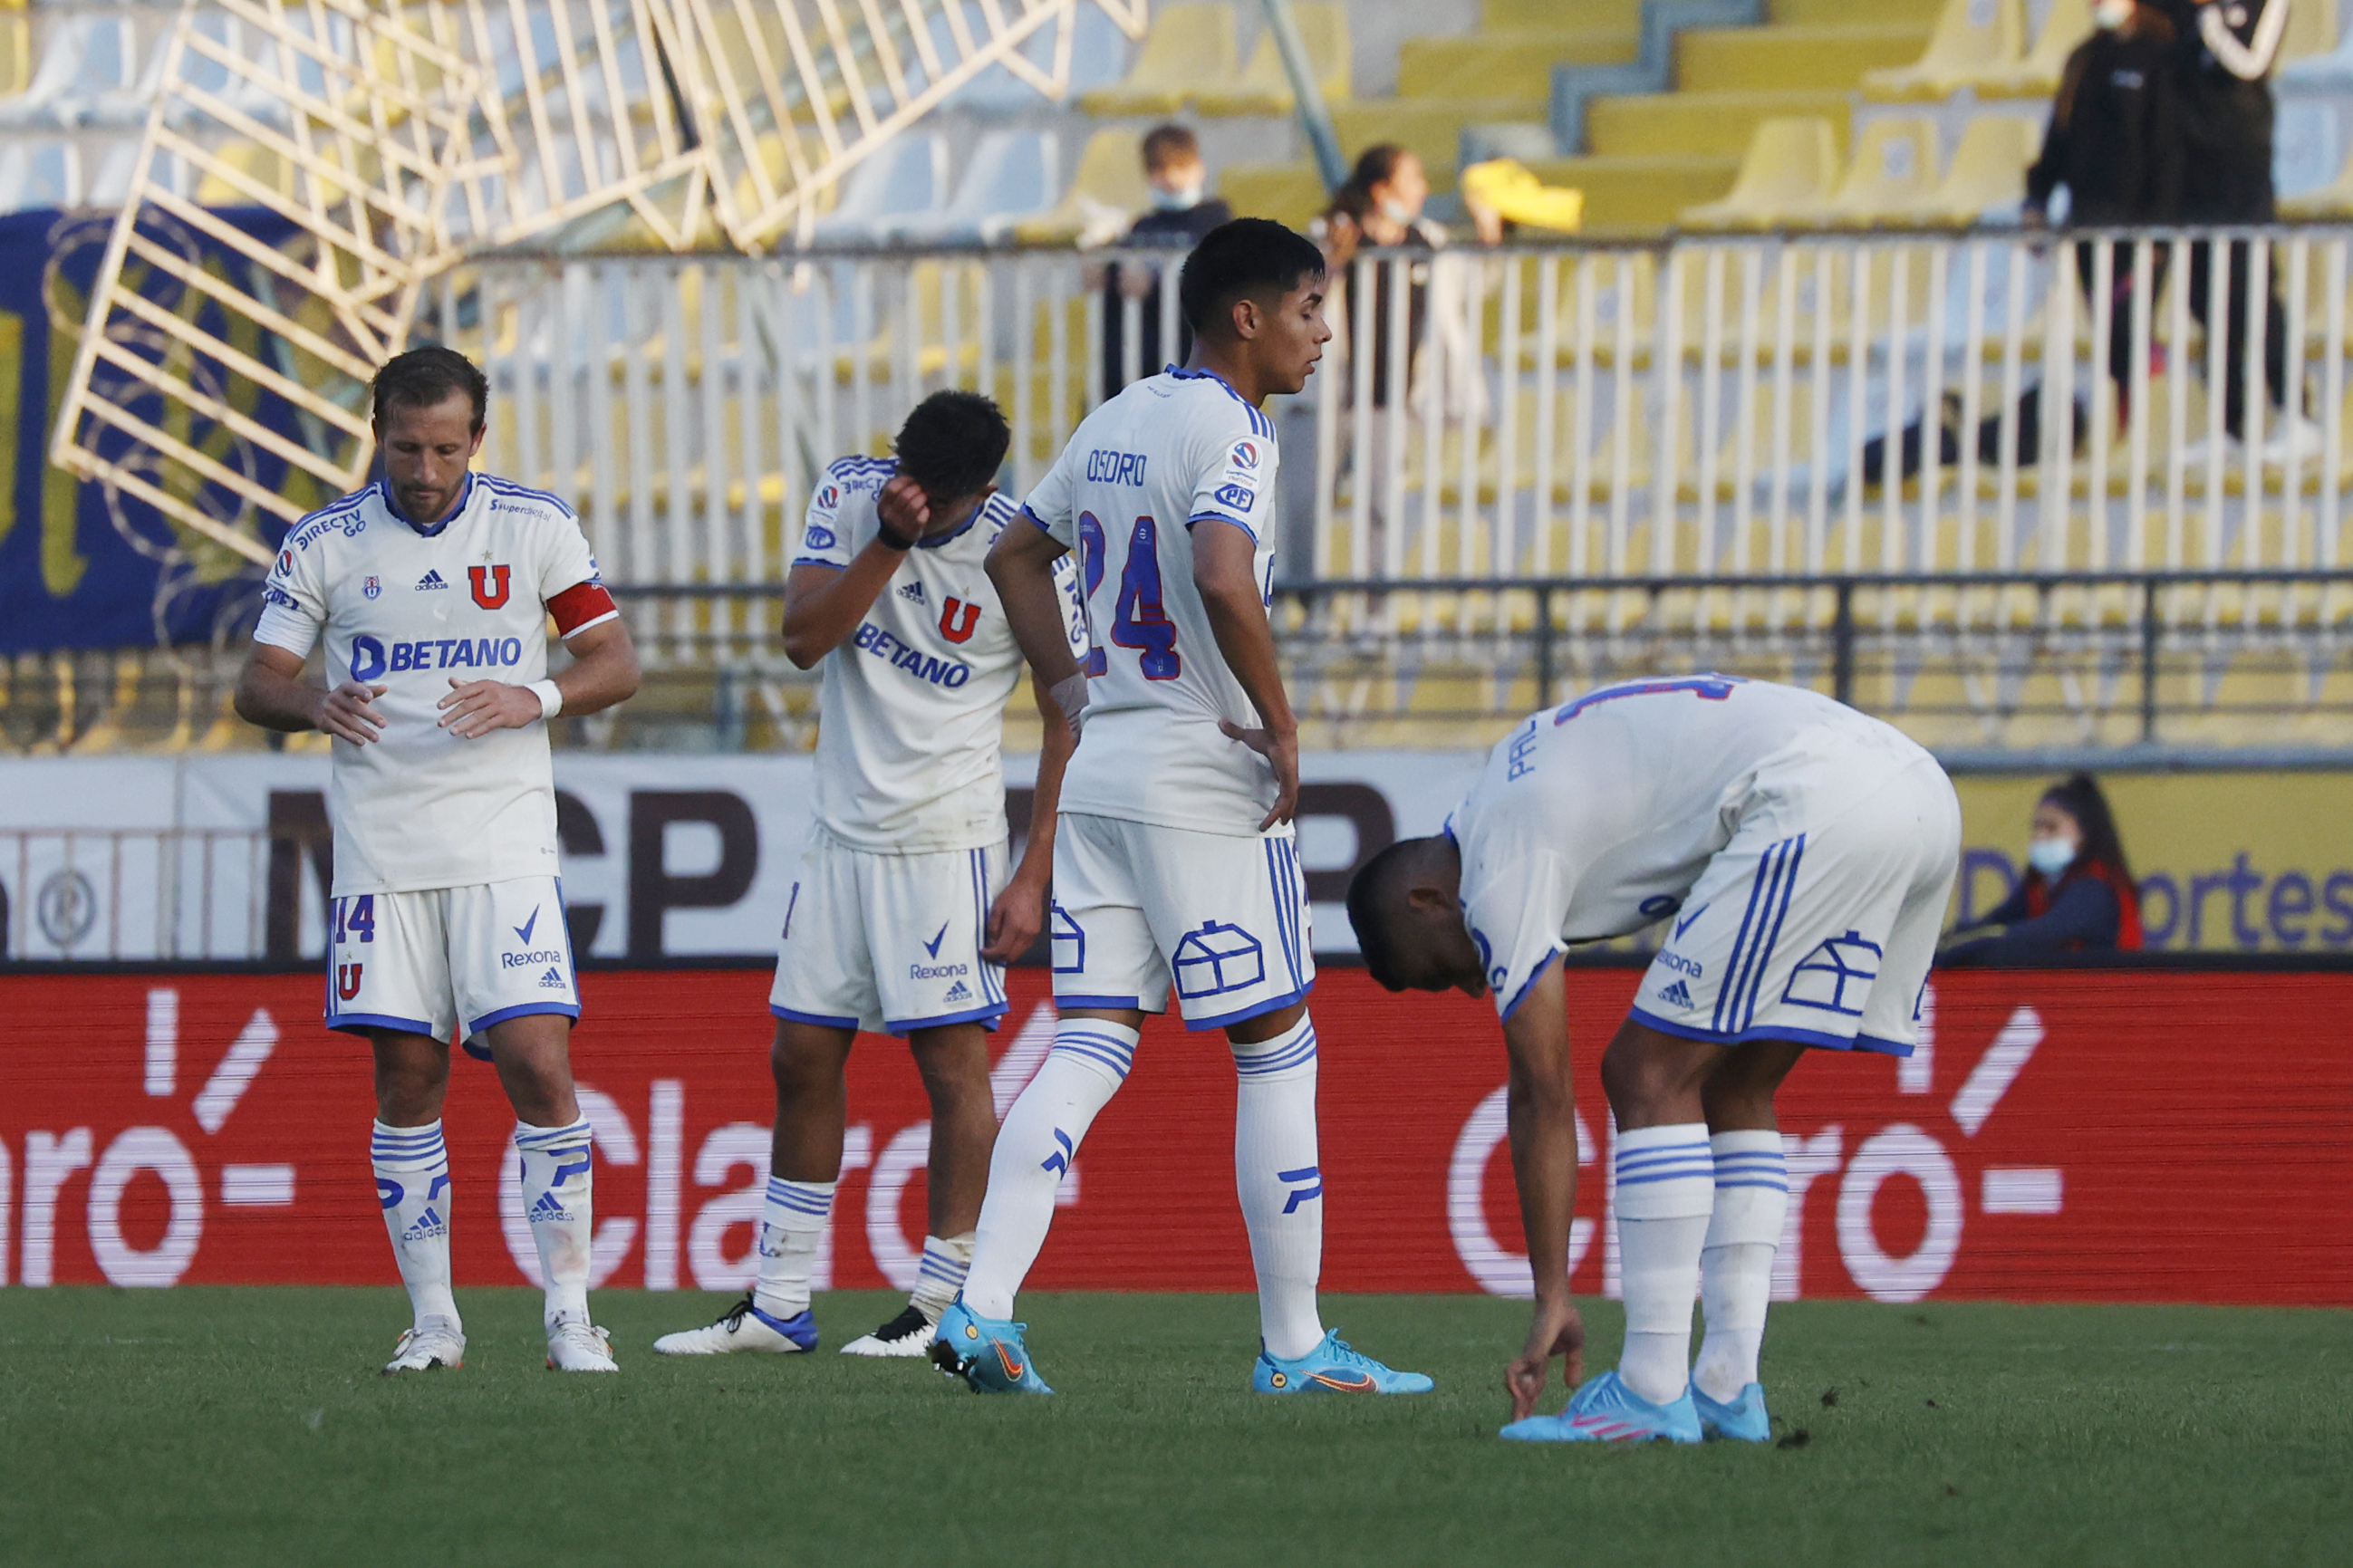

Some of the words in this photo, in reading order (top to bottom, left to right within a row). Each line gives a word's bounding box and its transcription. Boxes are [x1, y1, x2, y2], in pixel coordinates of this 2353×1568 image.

[498, 503, 552, 522] superdigital
[1226, 488, 1249, 505] PF
[295, 508, 361, 552] DIRECTV
[343, 520, 367, 538] GO
[414, 582, 449, 592] adidas
[468, 563, 511, 611] U
[1079, 510, 1181, 681] 24
[939, 595, 982, 645] U
[390, 637, 523, 672] BETANO
[853, 621, 969, 688] BETANO
[1960, 847, 2353, 951] Dortes
[335, 894, 375, 944] 14
[501, 950, 561, 969] Rexona
[910, 963, 968, 980] Rexona
[1657, 948, 1702, 979] exona
[338, 962, 363, 1002] U
[538, 980, 566, 990] adidas
[0, 1126, 205, 1288] ro
[1447, 1082, 1964, 1303] Cro
[403, 1225, 448, 1241] adidas
[529, 1208, 574, 1223] adidas
